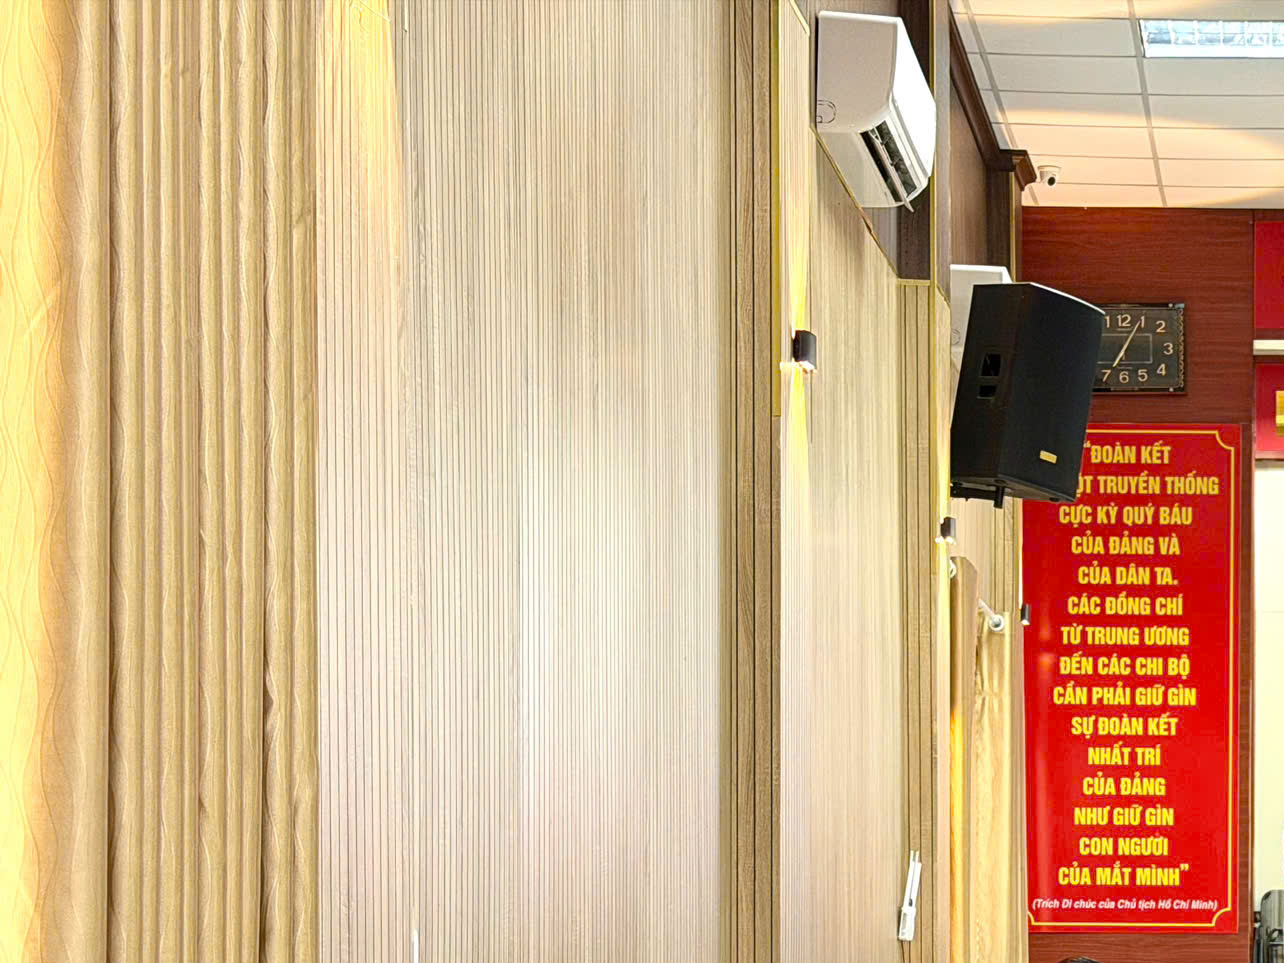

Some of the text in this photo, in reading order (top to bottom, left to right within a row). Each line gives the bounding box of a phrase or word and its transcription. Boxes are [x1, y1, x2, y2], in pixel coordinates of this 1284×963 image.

[1116, 314, 1132, 327] 12
[1140, 315, 1145, 328] 1
[1155, 320, 1167, 333] 2
[1163, 342, 1174, 355] 3
[1101, 363, 1167, 384] 7 6 5 4
[1141, 440, 1171, 464] KẾT
[1165, 470, 1219, 495] THỐNG
[1059, 504, 1092, 528] CỰC
[1122, 502, 1155, 526] QUÝ
[1159, 503, 1193, 525] BÁU
[1071, 530, 1180, 555] CỦA ĐẢNG VÀ
[1078, 560, 1179, 585] CỦA DÂN TA.
[1067, 591, 1183, 616] CÁC ĐỒNG CHÍ
[1061, 623, 1190, 646] TỪ TRUNG ƯƠNG
[1060, 651, 1190, 679] ĐẾN CÁC CHI BỘ
[1053, 681, 1197, 706] CẦN PHẢI GIỮ GÌN
[1071, 711, 1178, 738] SỰ ĐOÀN KẾT
[1088, 741, 1161, 766] NHẤT TRÍ
[1083, 771, 1165, 796] CỦA ĐẢNG
[1074, 803, 1174, 826] NHƯ GIỮ GÌN
[1079, 832, 1168, 856] CON NGƯỜI
[1058, 861, 1091, 886] CỦA
[1096, 862, 1131, 886] MẮT
